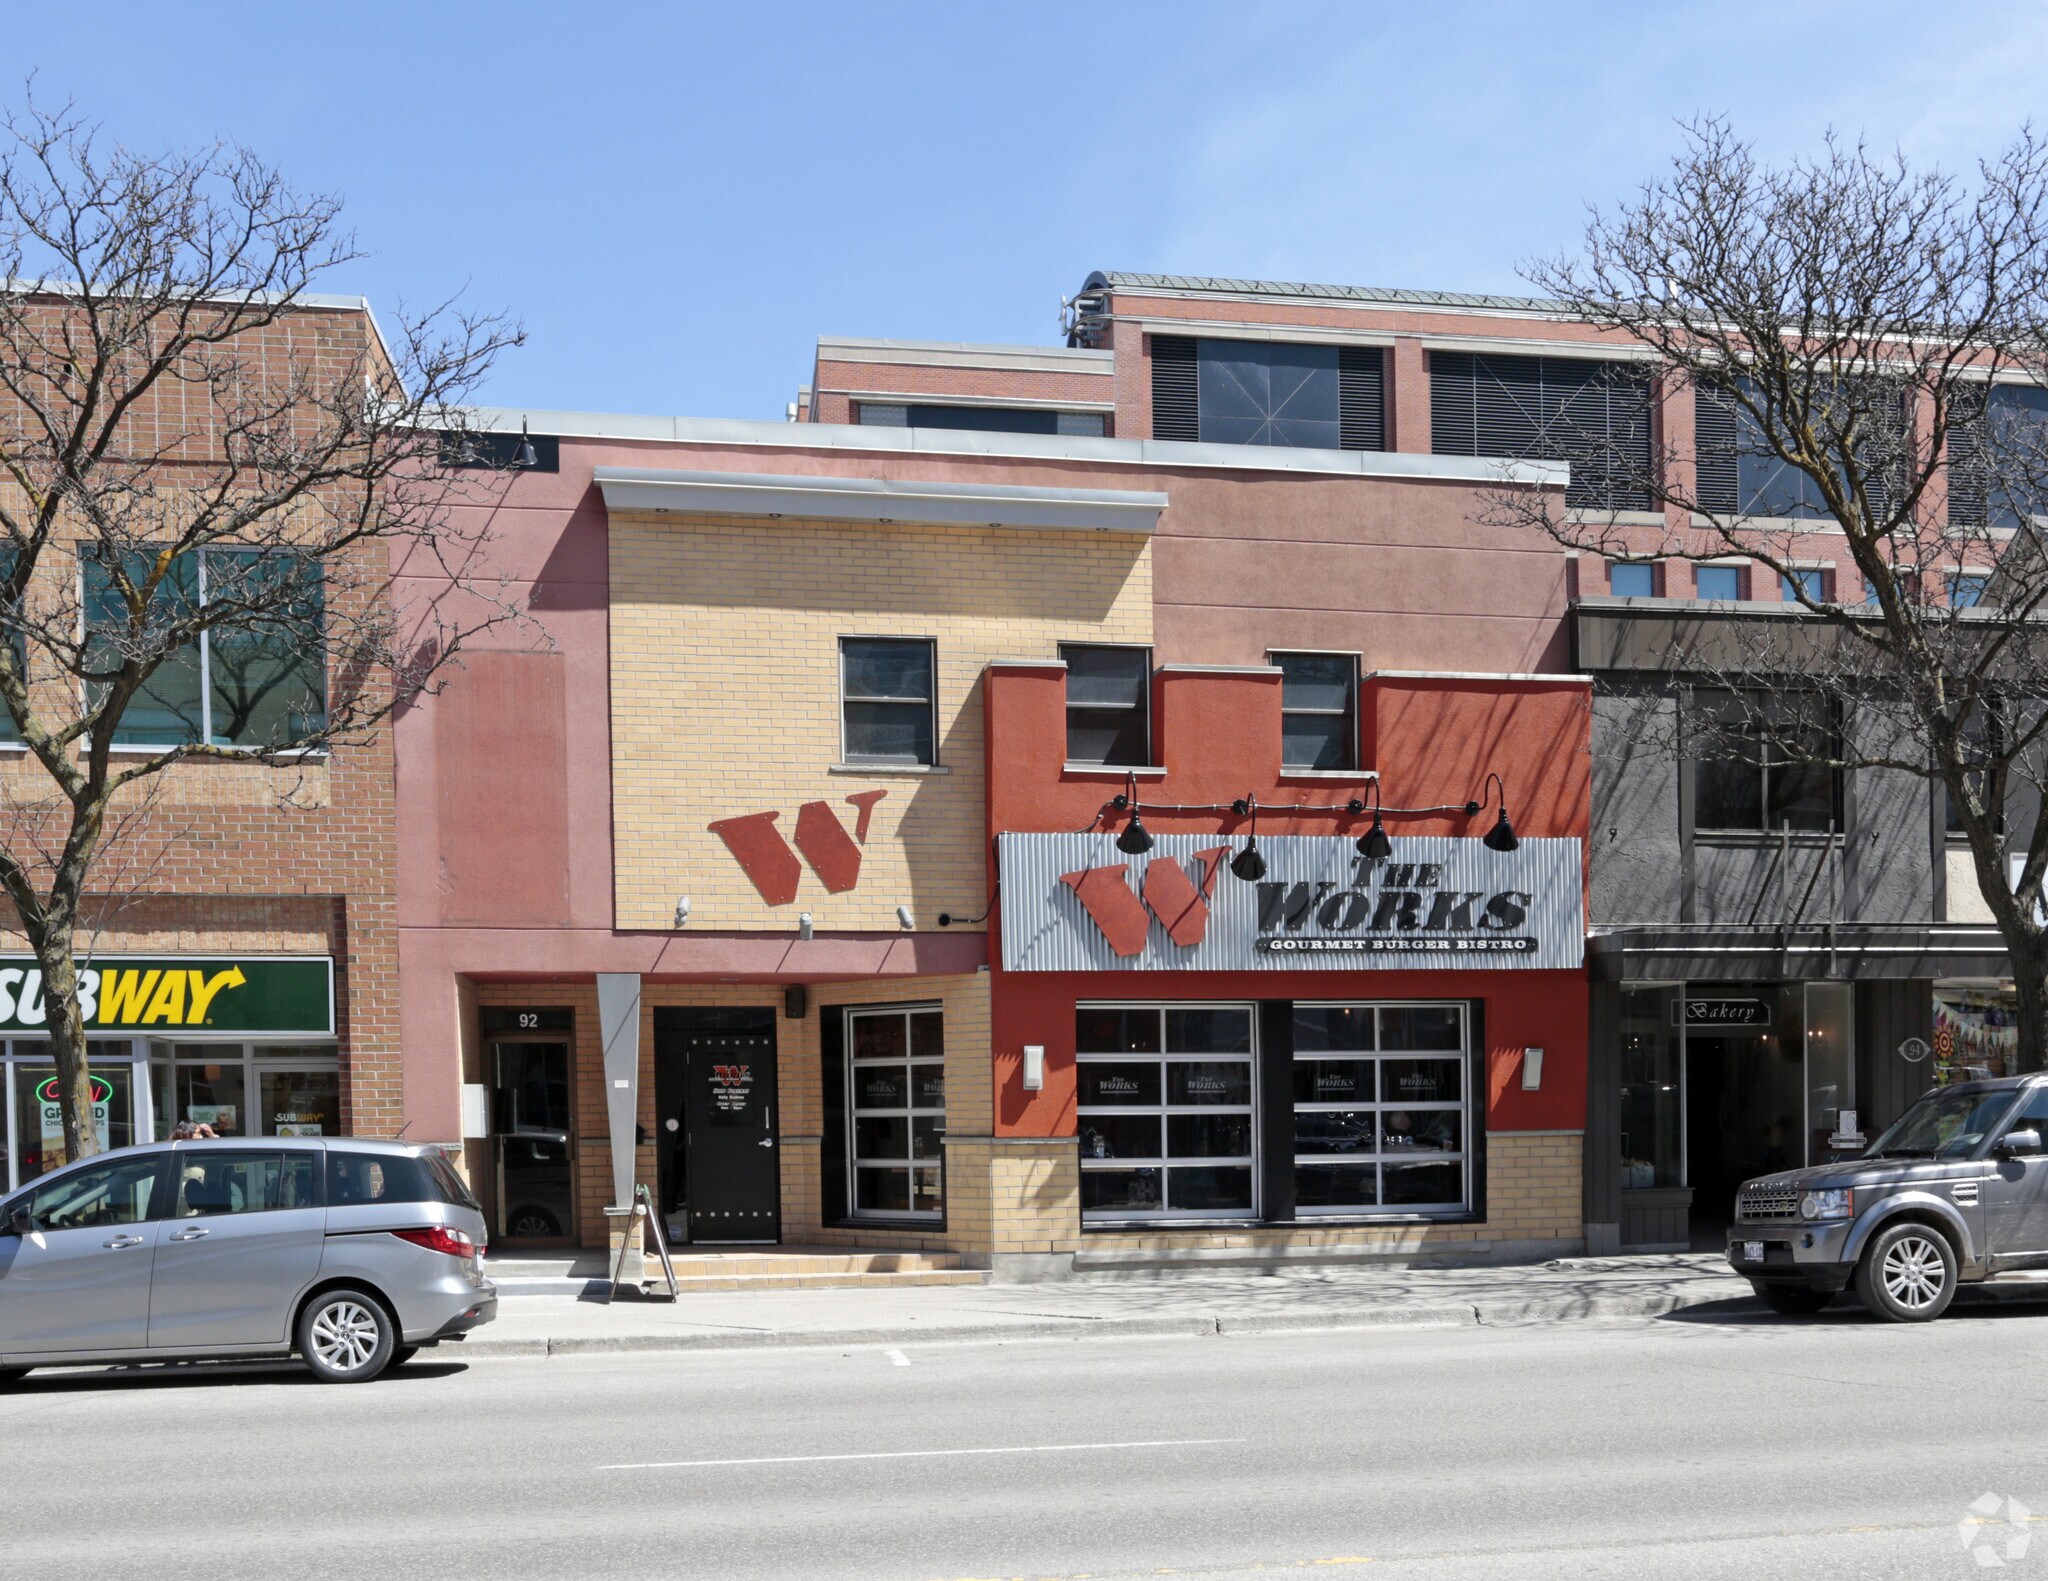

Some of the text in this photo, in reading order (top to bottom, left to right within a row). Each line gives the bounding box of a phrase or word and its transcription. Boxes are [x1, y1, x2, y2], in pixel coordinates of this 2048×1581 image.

[1256, 881, 1532, 931] WORKS
[1269, 939, 1527, 951] GOURMET BURGER BISTRO
[1686, 1003, 1755, 1023] Bakery
[519, 1013, 538, 1028] 92
[1909, 1044, 1920, 1055] 94
[1100, 1081, 1139, 1090] WORKS
[1188, 1080, 1226, 1089] WORKS
[1317, 1078, 1355, 1087] WORKS
[1400, 1077, 1437, 1086] WORKS
[274, 1112, 324, 1123] SUBWAY
